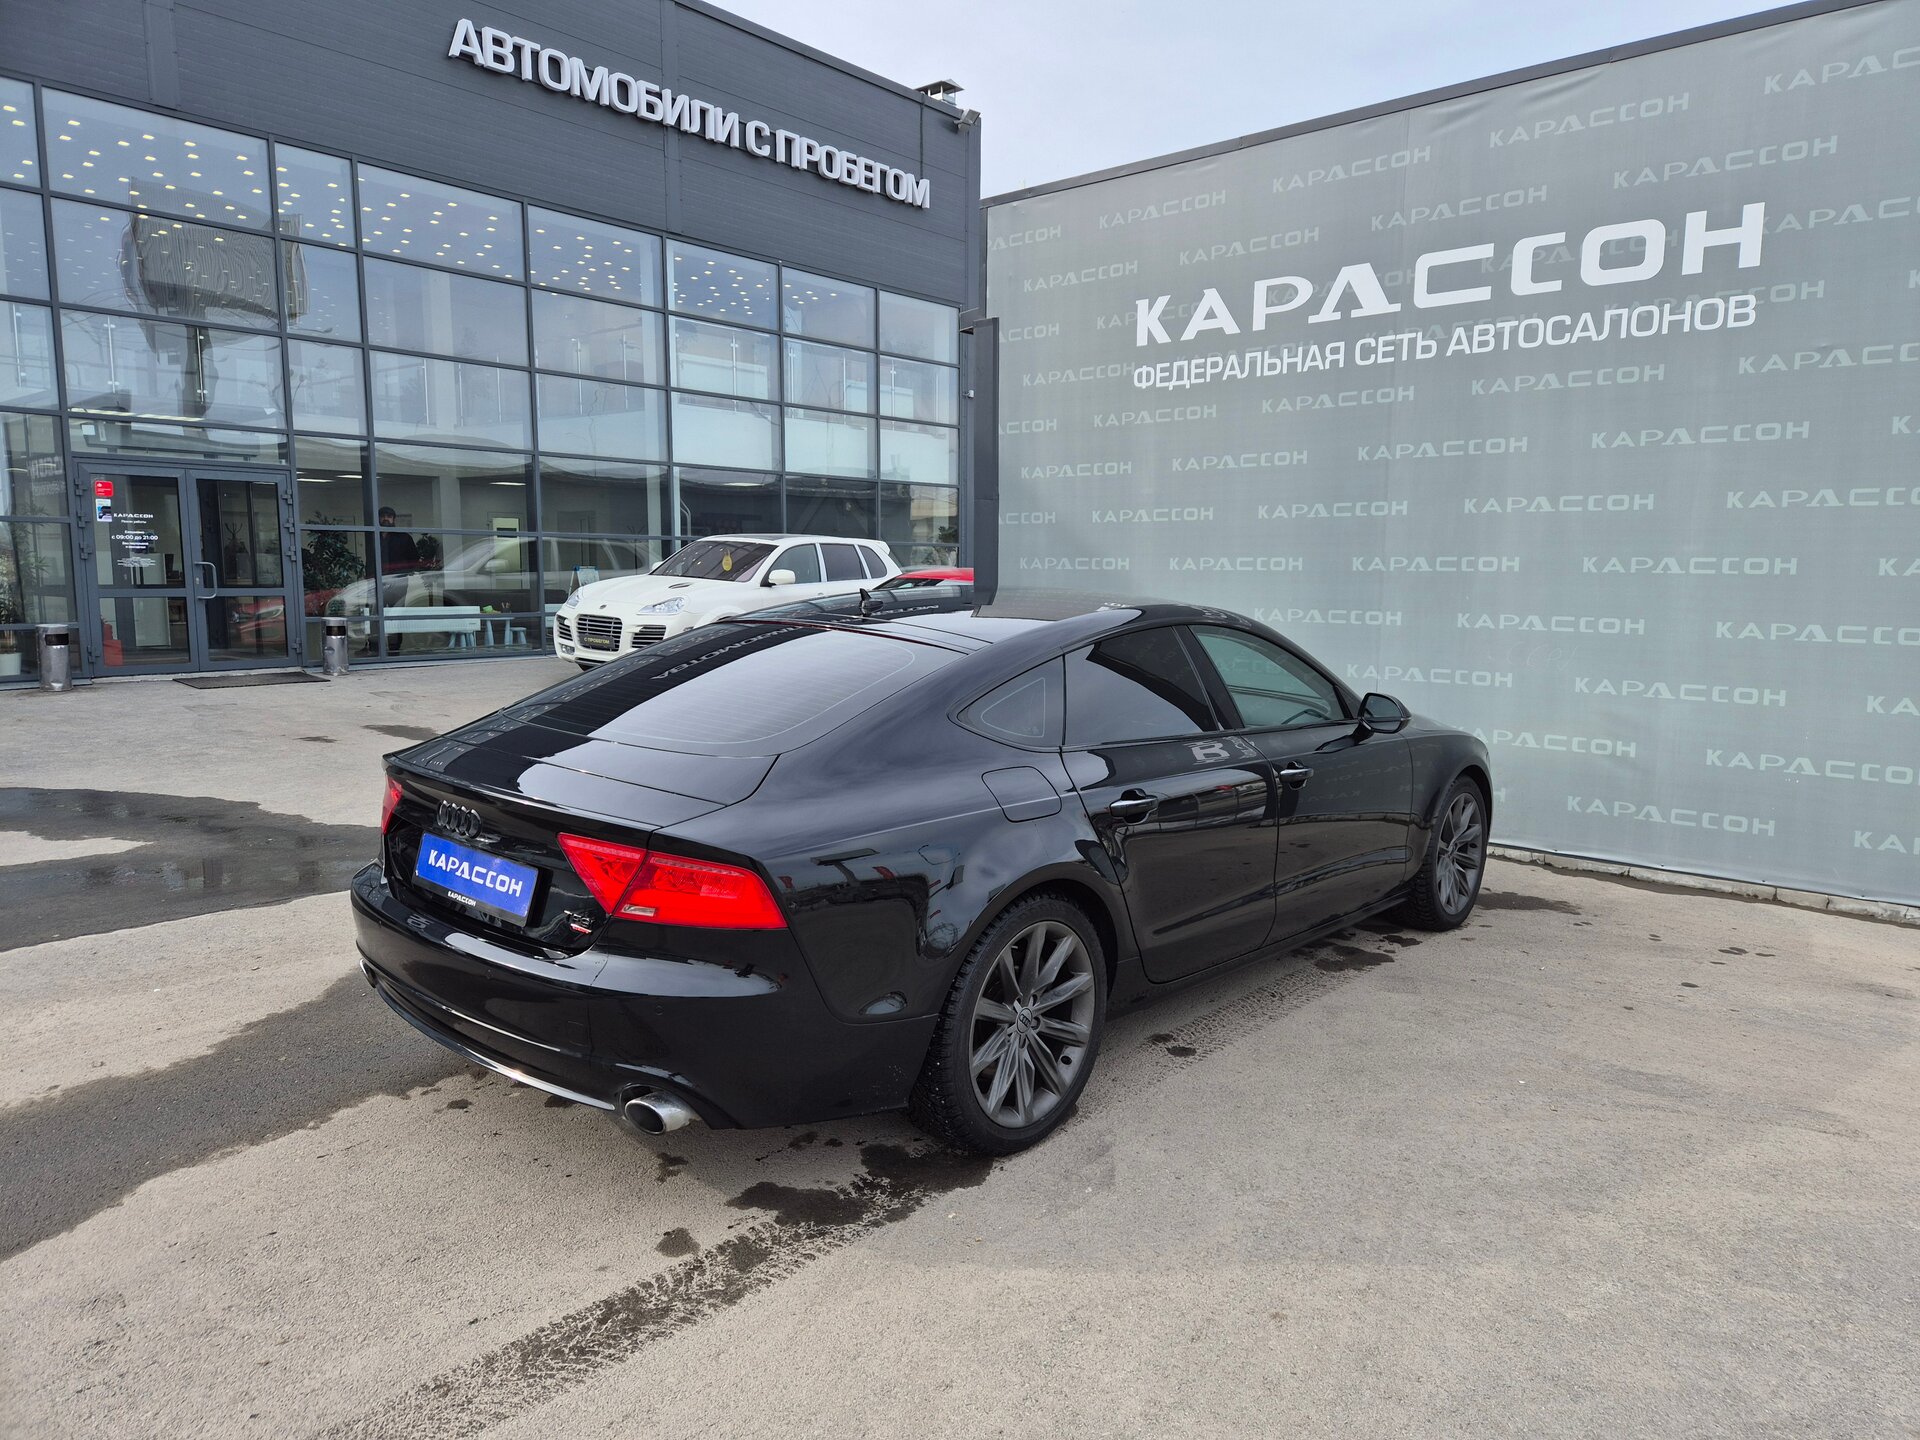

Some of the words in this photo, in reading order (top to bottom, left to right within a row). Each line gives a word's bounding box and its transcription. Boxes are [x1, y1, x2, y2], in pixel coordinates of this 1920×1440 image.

[449, 18, 740, 148] АВТОМОБИЛИ
[746, 120, 770, 157] С
[776, 129, 930, 209] ПРОБЕГОМ
[1489, 92, 1690, 148] КАРАССОН
[1271, 145, 1432, 194] КАРАССОН
[1613, 135, 1838, 189] КАРАССОН
[1098, 190, 1227, 230] КАРАССОН
[1370, 184, 1548, 232] КАРАССОН
[1763, 196, 1920, 235] АРАС
[1179, 227, 1320, 266] КАРАССОН
[1023, 260, 1139, 293] КАРАССОН
[1134, 202, 1767, 347] КАРАССОН
[1133, 340, 1346, 390] ФЕДЕРАЛЬНАЯ
[1354, 331, 1438, 367] СЕТЬ
[1445, 294, 1757, 357] АВТОСАЛОНОВ
[1022, 362, 1136, 387] КАРАССОН
[1471, 363, 1666, 396] КАРАССОН
[1261, 385, 1415, 415] КАРАССОН
[1093, 404, 1217, 428] КАРАССОН
[1357, 436, 1529, 461] КАРАССОН
[1591, 420, 1811, 449] КАРАССОН
[1020, 461, 1133, 480] КАРАССОН
[1171, 450, 1309, 472] КАРАССОН
[1091, 507, 1214, 523] КАРАССОН
[1257, 500, 1409, 519] КАРАССОН
[1463, 493, 1655, 514] КАРАССОН
[1019, 557, 1130, 571] КАРАССОН
[1169, 556, 1304, 572] КАРАССОН
[1352, 556, 1521, 573] КАРАССОН
[1582, 556, 1799, 576] КАРАССОН
[1254, 607, 1404, 627] КАРАССОН
[1457, 612, 1646, 635] КАРАССОН
[1346, 663, 1514, 689] КАРАССОН
[1575, 677, 1788, 708] КАРАССОН
[1474, 727, 1638, 759] АРАССОН
[1705, 749, 1920, 786] КАРАССО
[1567, 795, 1776, 837] КАРАССОН
[428, 849, 523, 897] КАРАССОН
[448, 890, 477, 907] КАРАССОН
